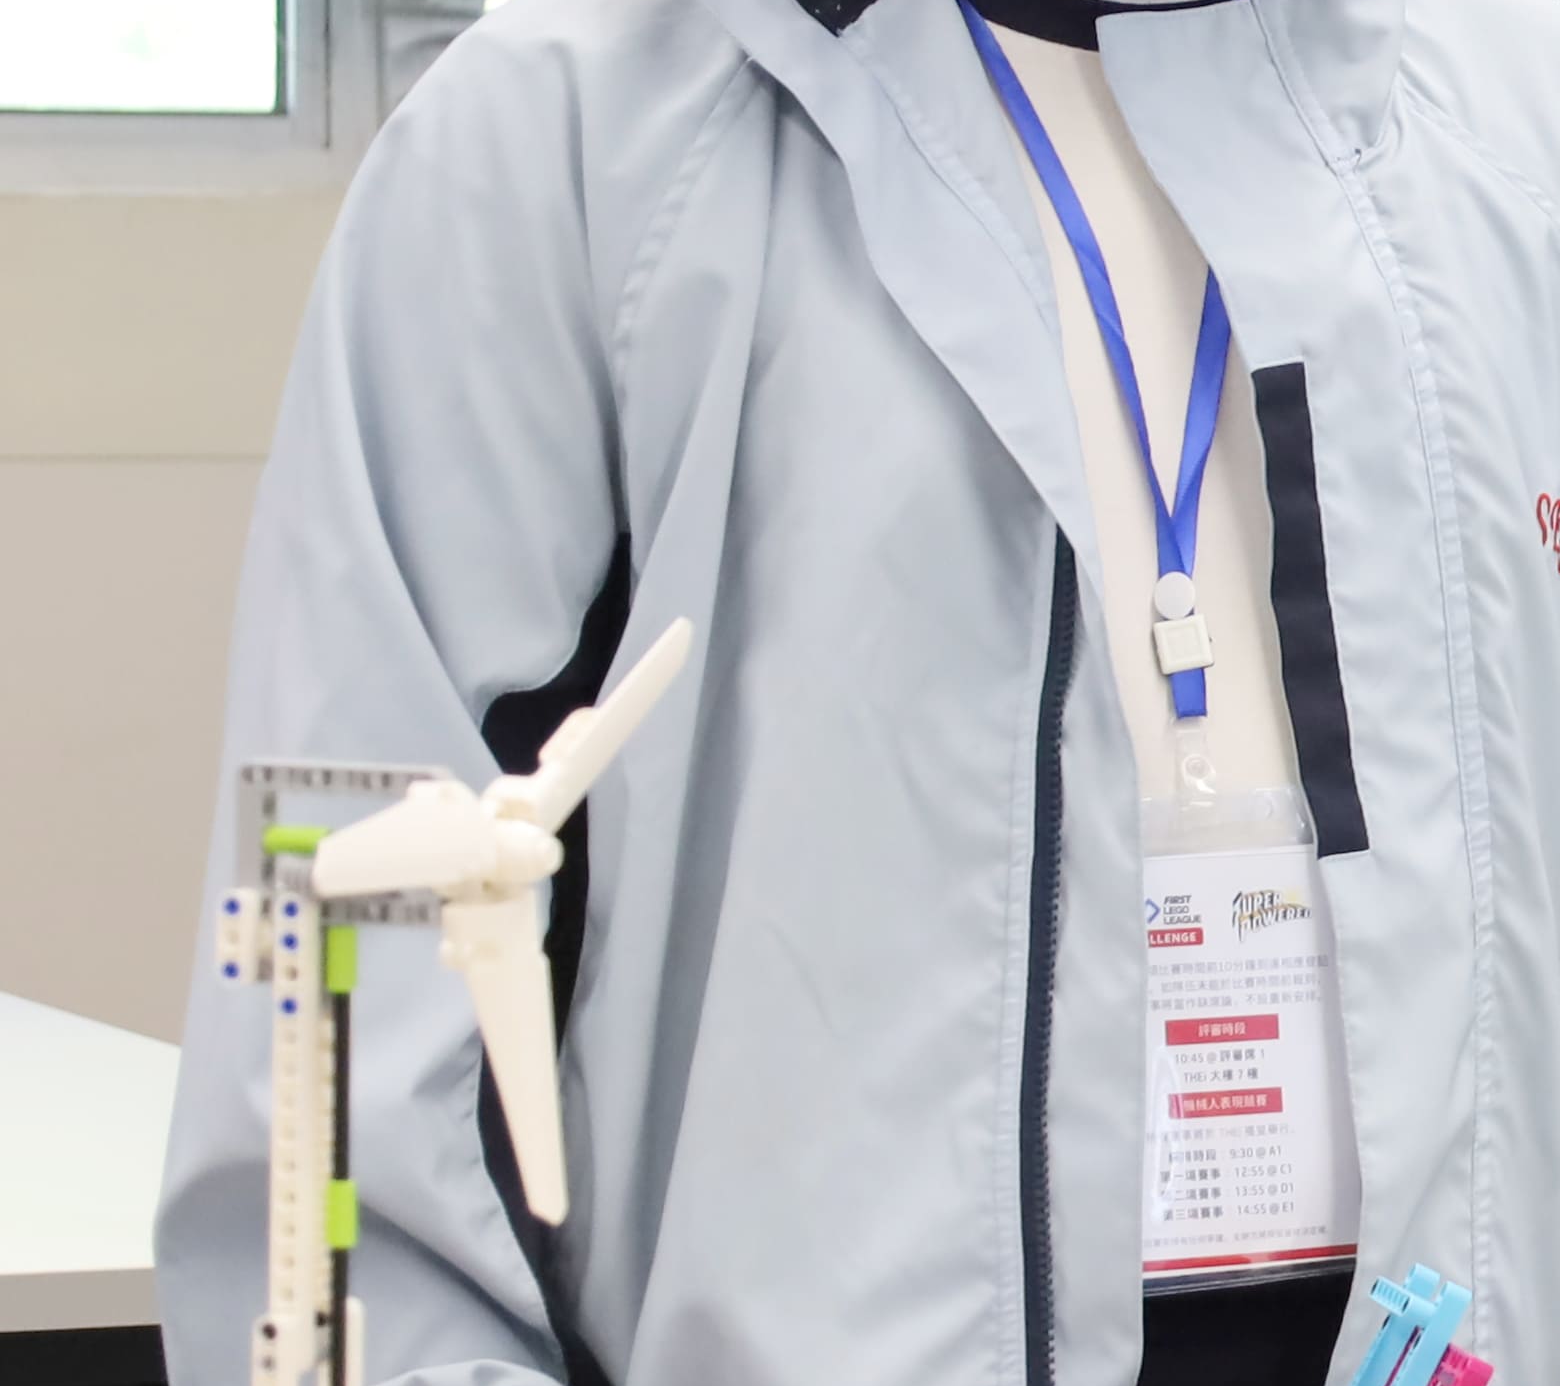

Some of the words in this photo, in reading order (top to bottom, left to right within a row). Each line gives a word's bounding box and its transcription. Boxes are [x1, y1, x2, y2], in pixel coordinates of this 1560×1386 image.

[1163, 895, 1192, 905] FIRST
[1163, 905, 1190, 915] LEGO
[1163, 914, 1202, 925] LEAGUE
